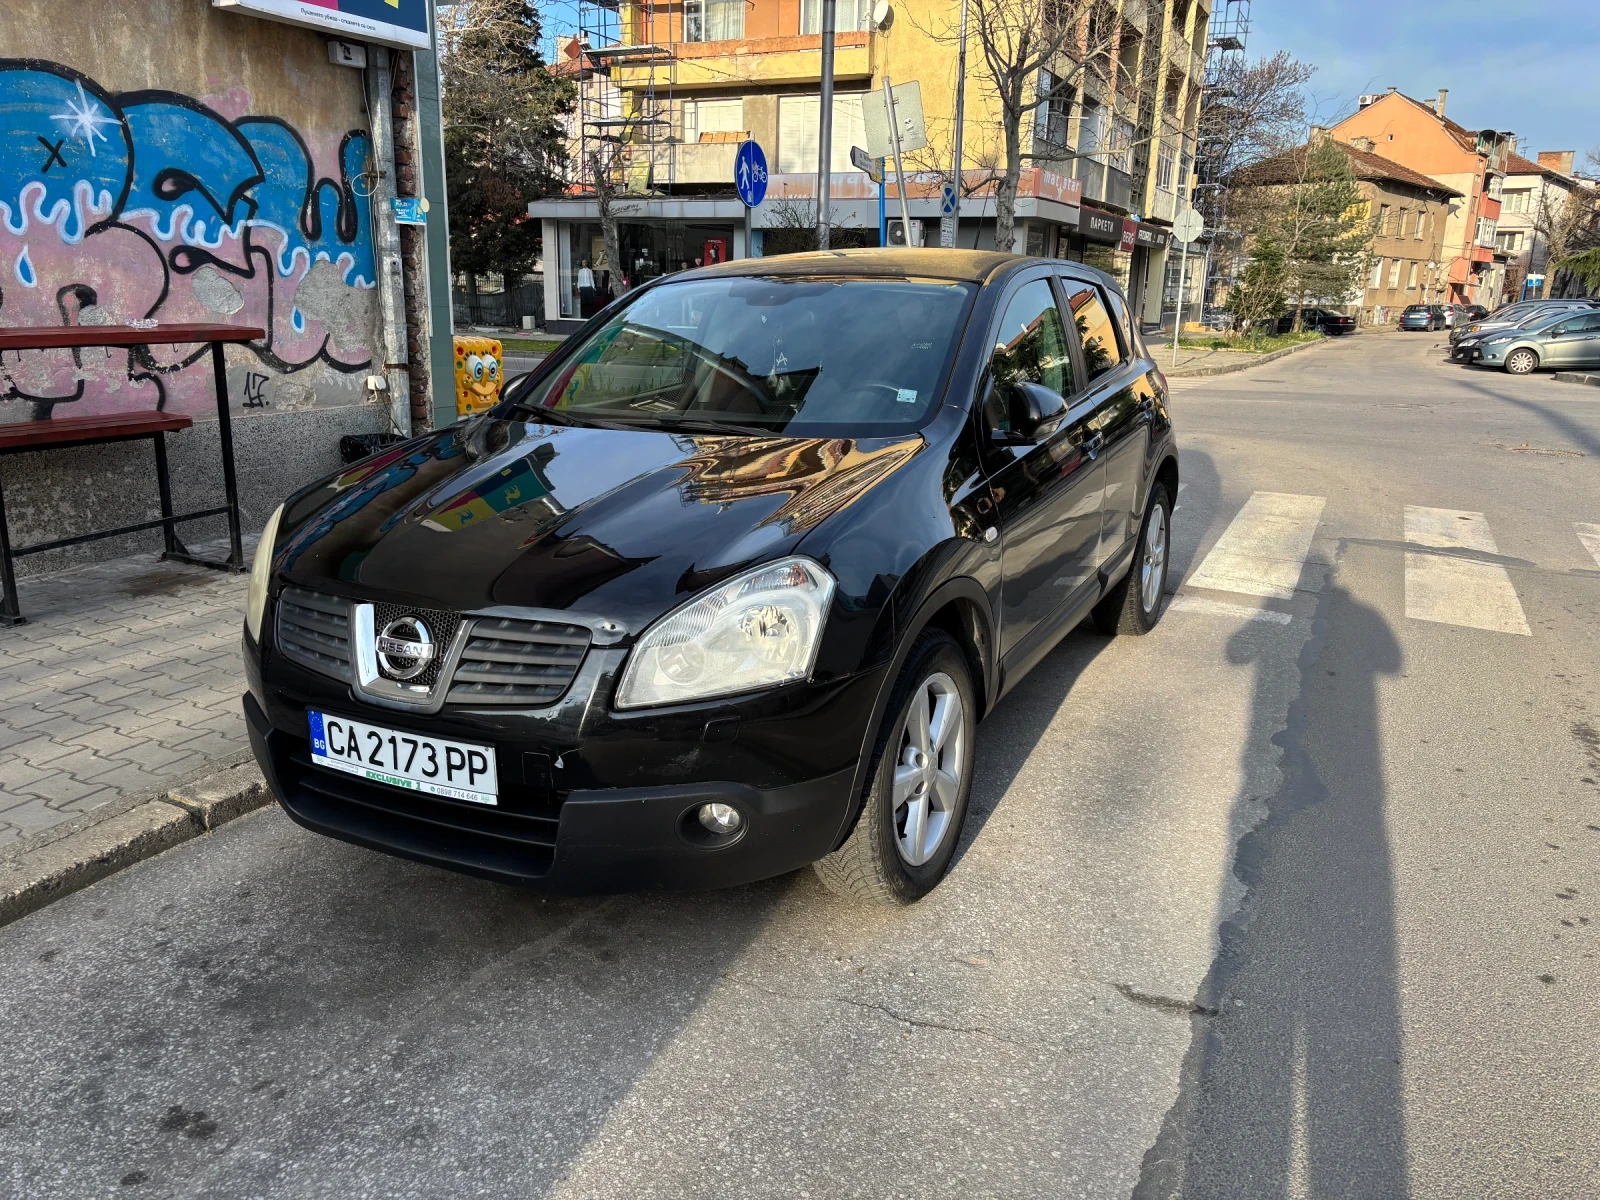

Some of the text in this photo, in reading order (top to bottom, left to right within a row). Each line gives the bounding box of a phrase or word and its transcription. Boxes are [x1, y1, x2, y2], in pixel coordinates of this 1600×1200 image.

[1062, 178, 1080, 193] star
[1090, 216, 1114, 233] ПАРКЕТИ
[380, 640, 423, 656] NISSAN
[314, 737, 326, 750] BG
[365, 769, 422, 791] EXCLUSIVE 1
[453, 790, 465, 799] 714
[466, 792, 479, 801] 646
